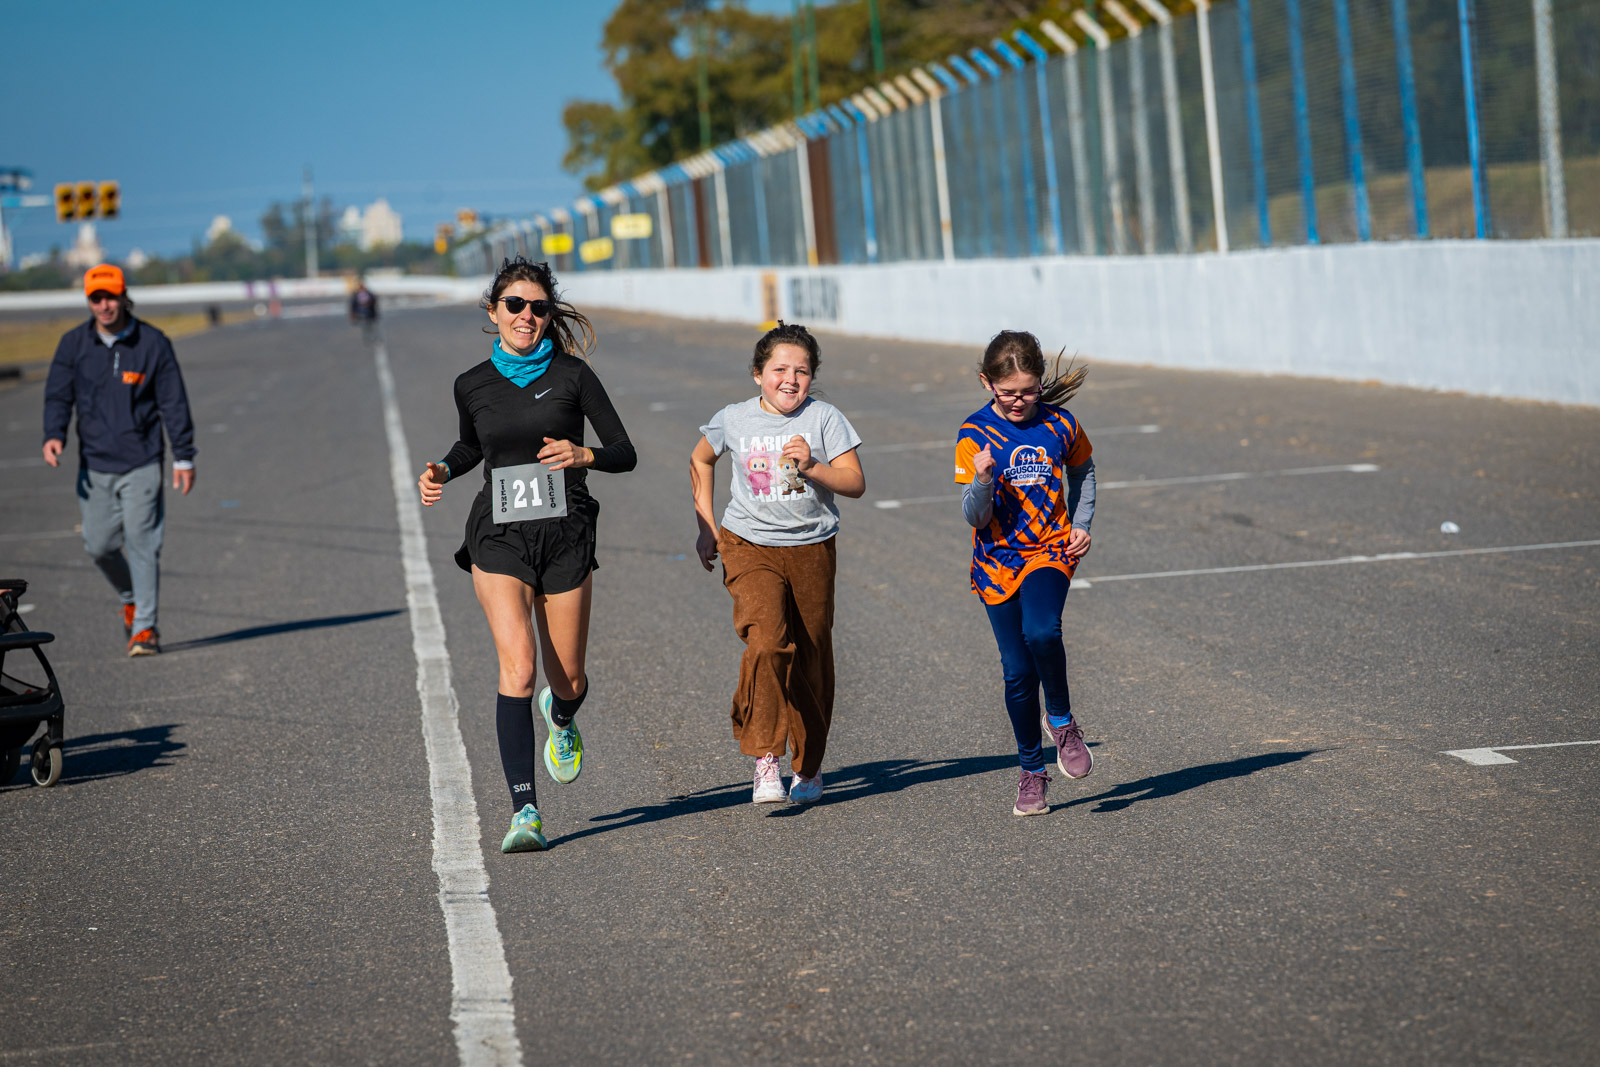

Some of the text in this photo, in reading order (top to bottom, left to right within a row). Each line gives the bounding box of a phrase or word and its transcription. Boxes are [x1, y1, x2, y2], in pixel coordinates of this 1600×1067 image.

[1036, 448, 1046, 462] 2
[1005, 465, 1051, 477] EGUSQUIZA
[512, 477, 543, 508] 21
[547, 474, 556, 509] EXACTO
[513, 782, 531, 793] SOX
